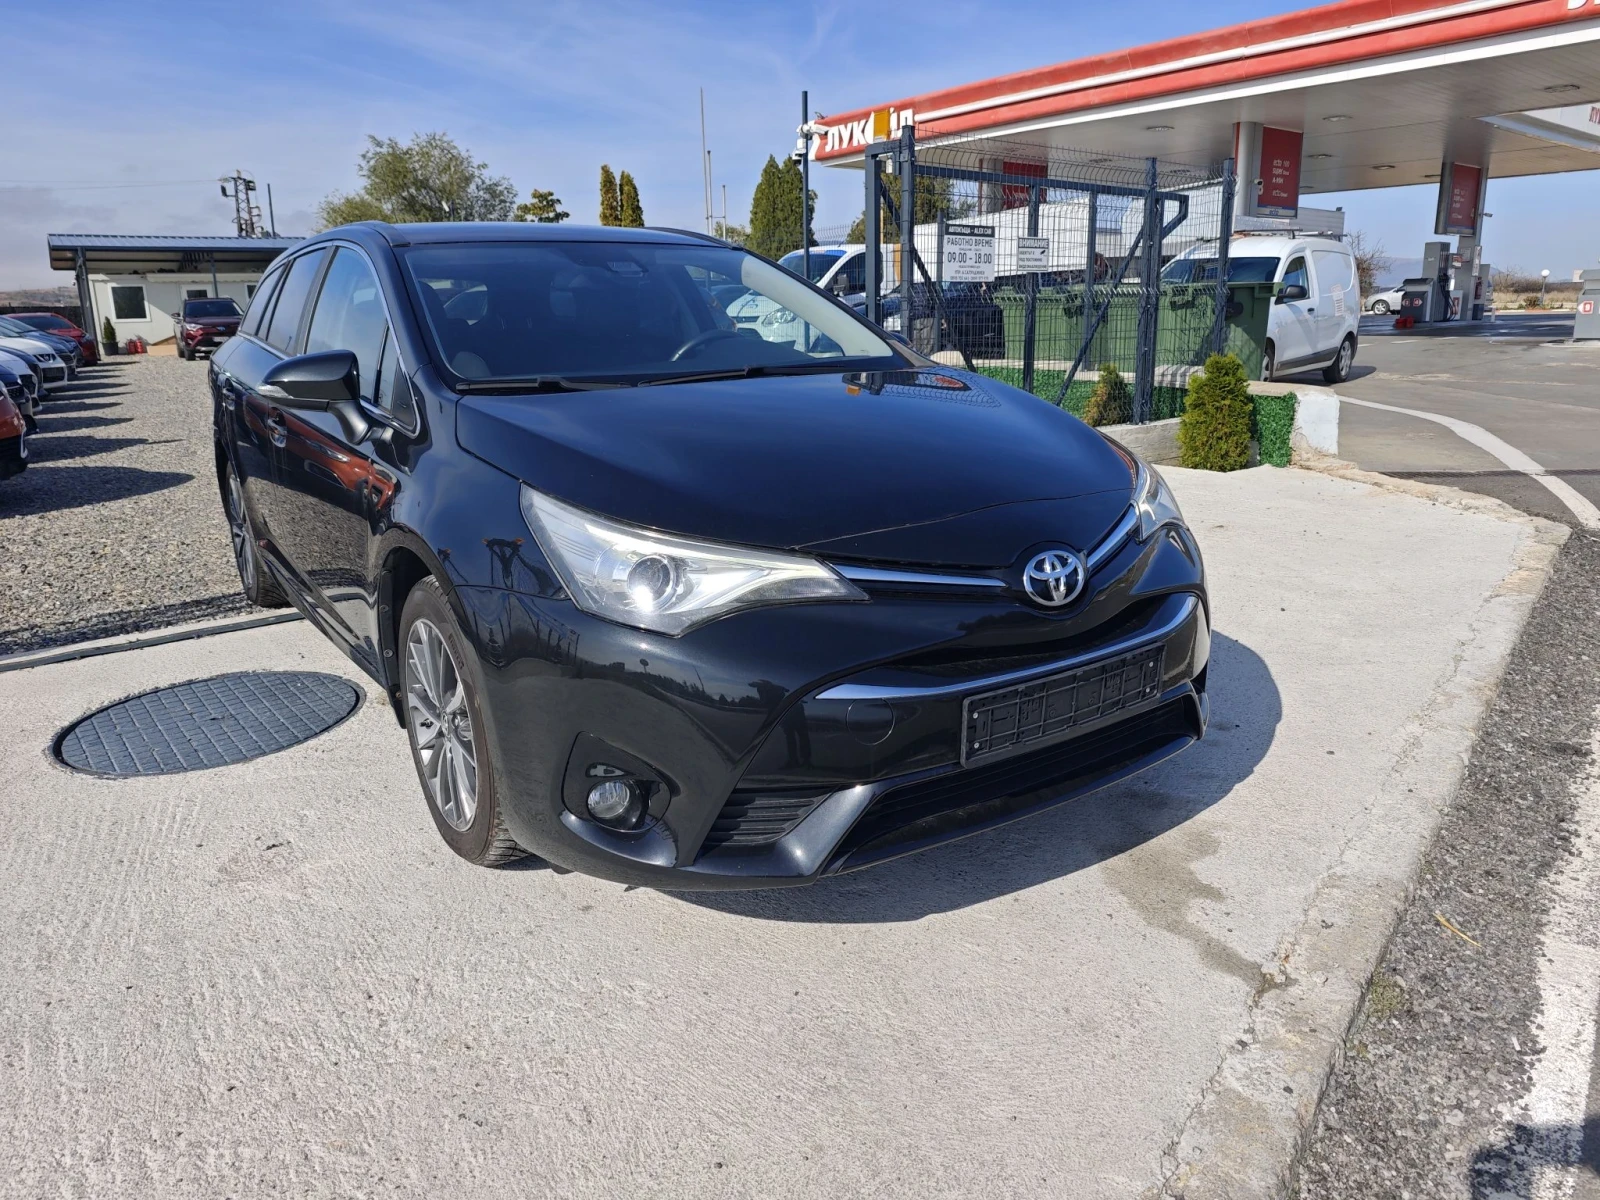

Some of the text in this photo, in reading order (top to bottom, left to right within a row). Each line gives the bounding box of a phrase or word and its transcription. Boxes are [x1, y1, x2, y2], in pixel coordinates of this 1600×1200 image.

[947, 237, 993, 248] РАБОТНО ВРЕМЕ
[1018, 238, 1048, 248] ВНИМАНИЕ
[947, 251, 967, 263] 09.00
[974, 253, 992, 264] 18.00
